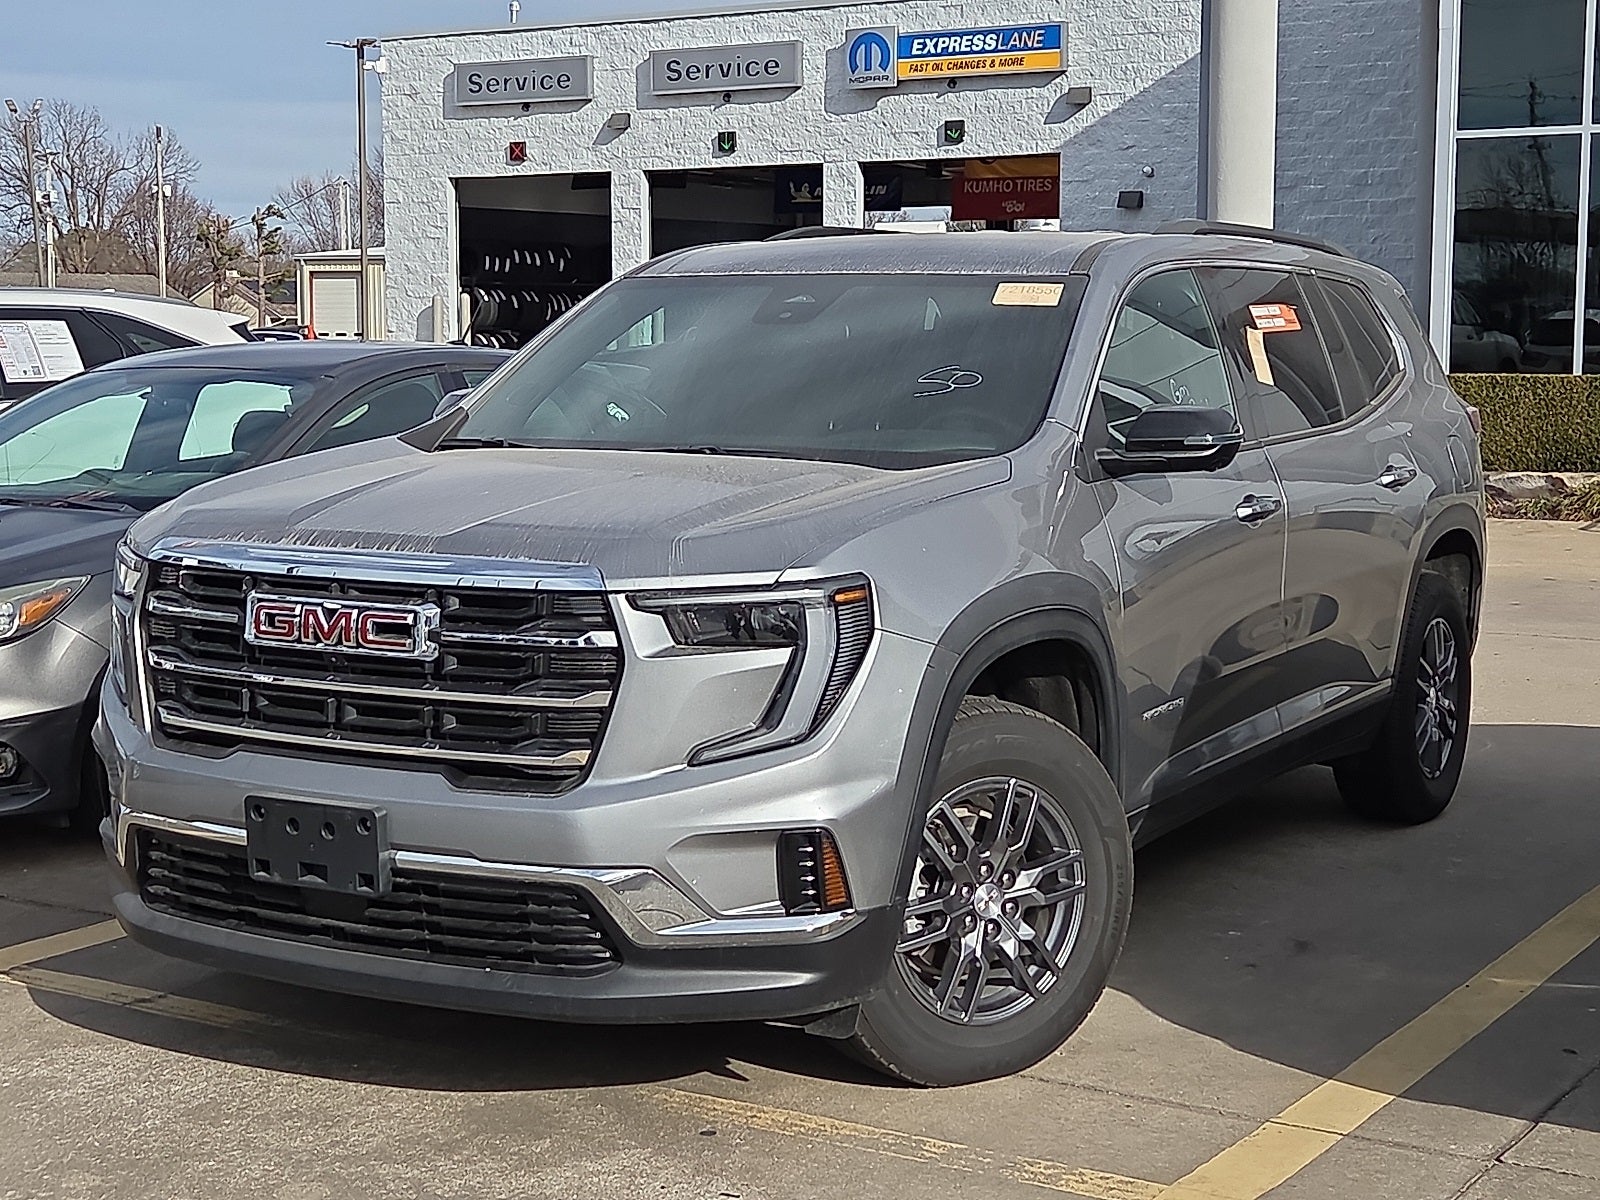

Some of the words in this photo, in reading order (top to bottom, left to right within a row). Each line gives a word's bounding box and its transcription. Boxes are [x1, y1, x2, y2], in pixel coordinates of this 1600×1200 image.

[666, 54, 781, 83] Service
[908, 62, 929, 74] FAST
[931, 61, 944, 73] OIL
[946, 59, 987, 72] CHANGES
[988, 58, 996, 69] &
[997, 56, 1026, 68] MORE
[467, 68, 572, 95] Service
[963, 179, 1013, 194] KUMHO
[1016, 178, 1052, 192] TIRES
[253, 602, 415, 650] GMC
